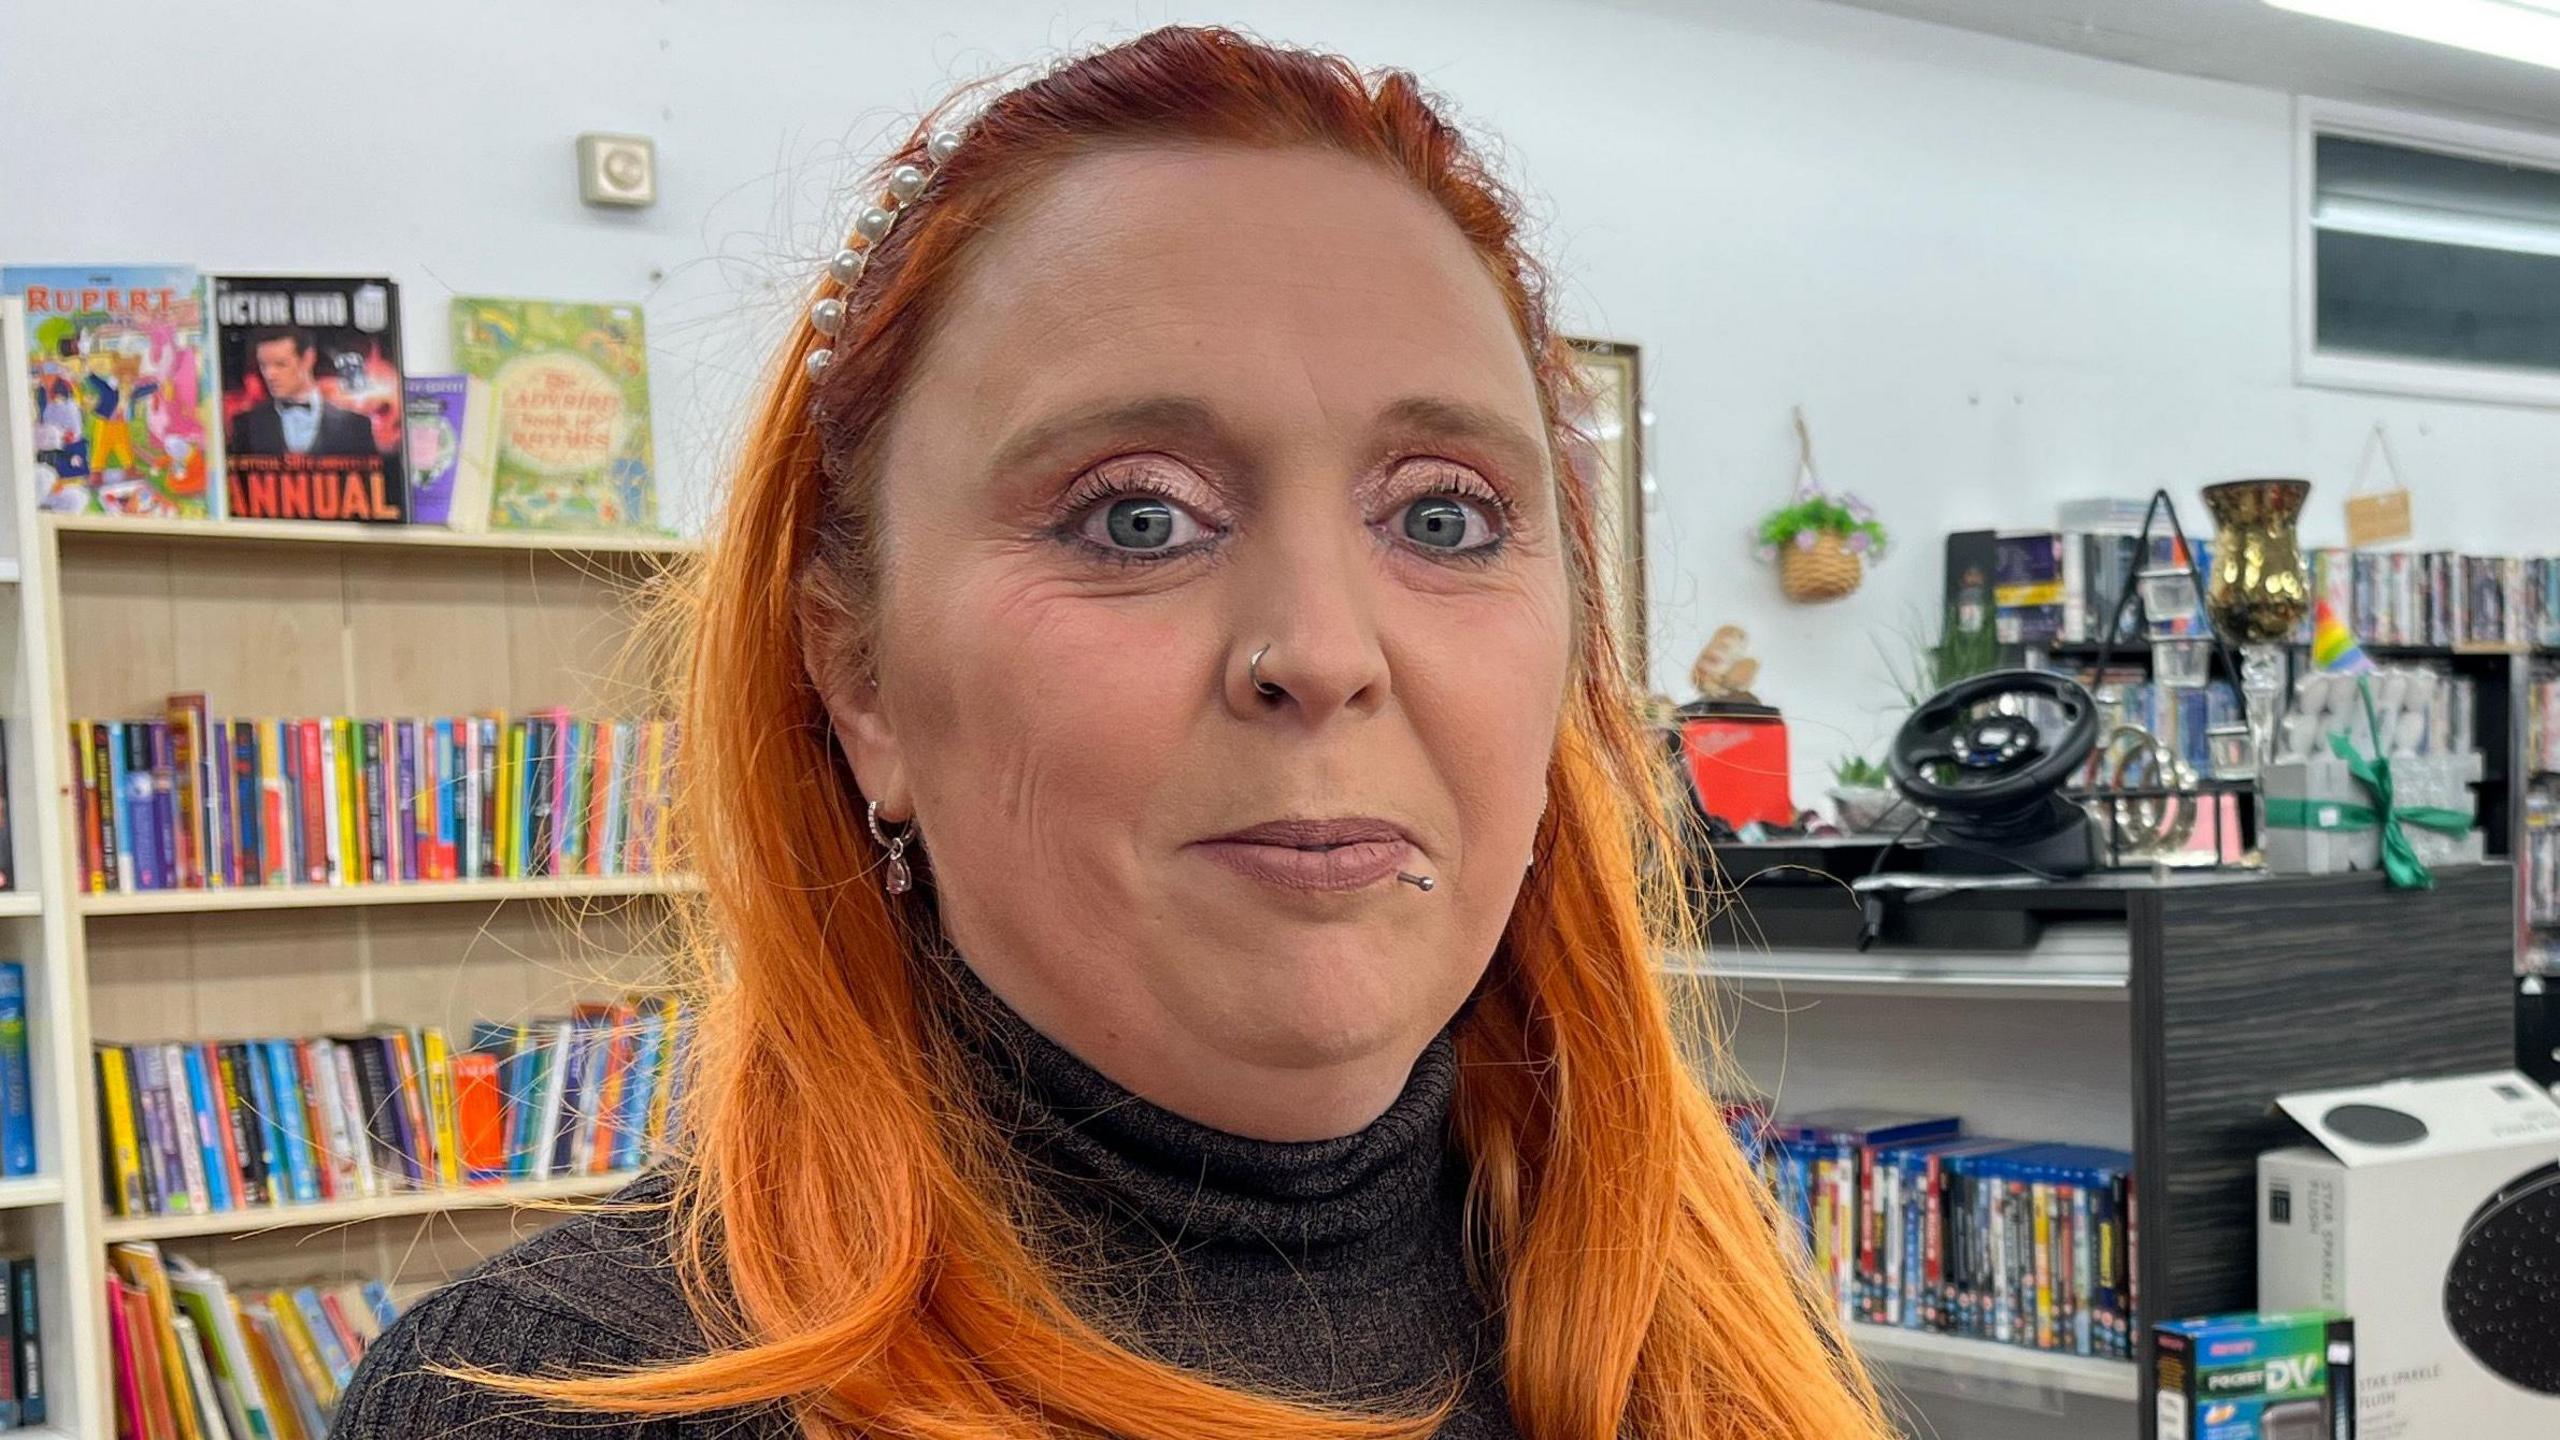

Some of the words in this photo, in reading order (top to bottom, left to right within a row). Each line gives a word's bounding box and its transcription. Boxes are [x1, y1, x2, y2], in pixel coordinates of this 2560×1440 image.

[27, 285, 176, 313] RUPERT
[218, 291, 290, 326] OCTOR
[294, 291, 347, 326] WHO
[2321, 1230, 2334, 1301] SPARKLE
[2208, 1370, 2264, 1391] POCKET
[2265, 1353, 2319, 1394] DV
[2359, 1376, 2387, 1391] STAR
[2392, 1365, 2442, 1385] SPARKLE
[2360, 1393, 2396, 1408] FLUSH
